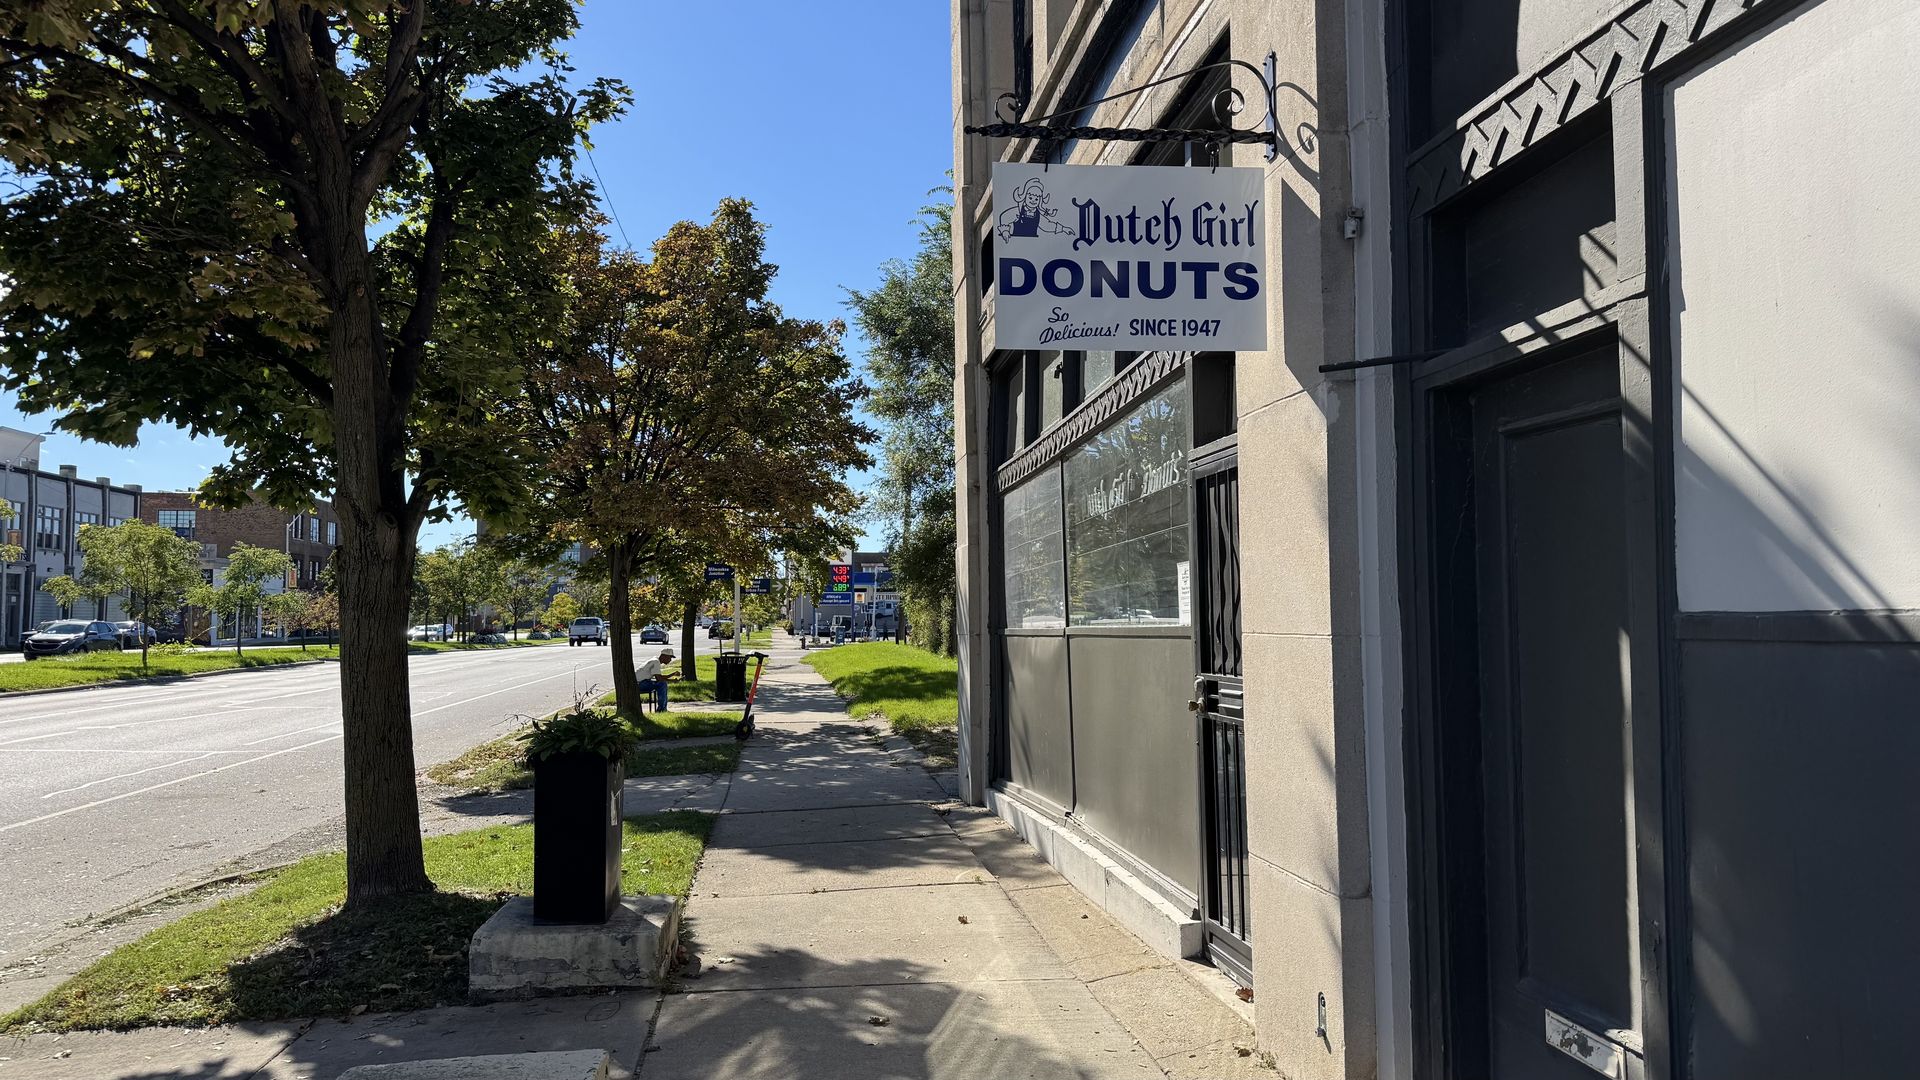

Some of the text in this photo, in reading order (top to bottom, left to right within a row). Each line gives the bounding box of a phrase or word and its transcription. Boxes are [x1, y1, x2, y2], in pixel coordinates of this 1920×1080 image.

[1072, 197, 1259, 251] Dutch Girl
[999, 257, 1260, 300] DONUTS
[1048, 306, 1070, 323] So
[1039, 323, 1120, 345] Delicious!
[1129, 318, 1221, 337] SINCE 1947
